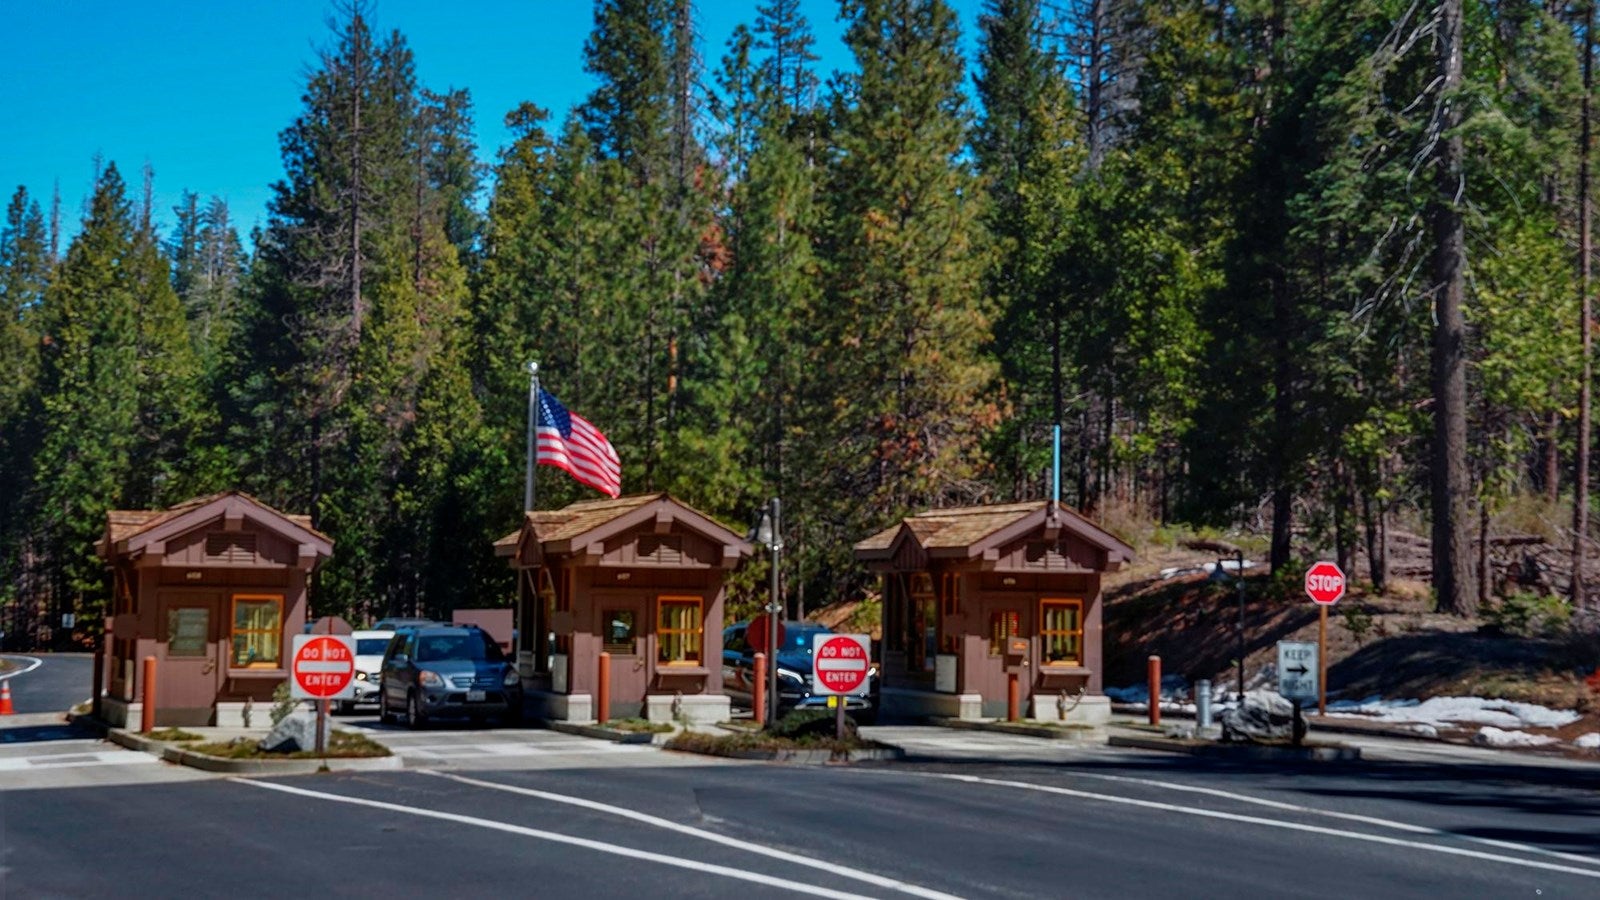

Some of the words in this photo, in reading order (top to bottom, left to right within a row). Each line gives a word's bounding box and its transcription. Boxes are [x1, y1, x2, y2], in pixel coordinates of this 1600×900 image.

[1308, 574, 1341, 592] STOP
[302, 647, 319, 659] DO
[324, 648, 346, 659] NOT
[821, 646, 837, 657] DO
[841, 646, 861, 657] NOT
[1283, 649, 1312, 661] KEEP
[305, 674, 341, 686] ENTER
[825, 671, 857, 683] ENTER
[1282, 678, 1313, 690] RIGHT
